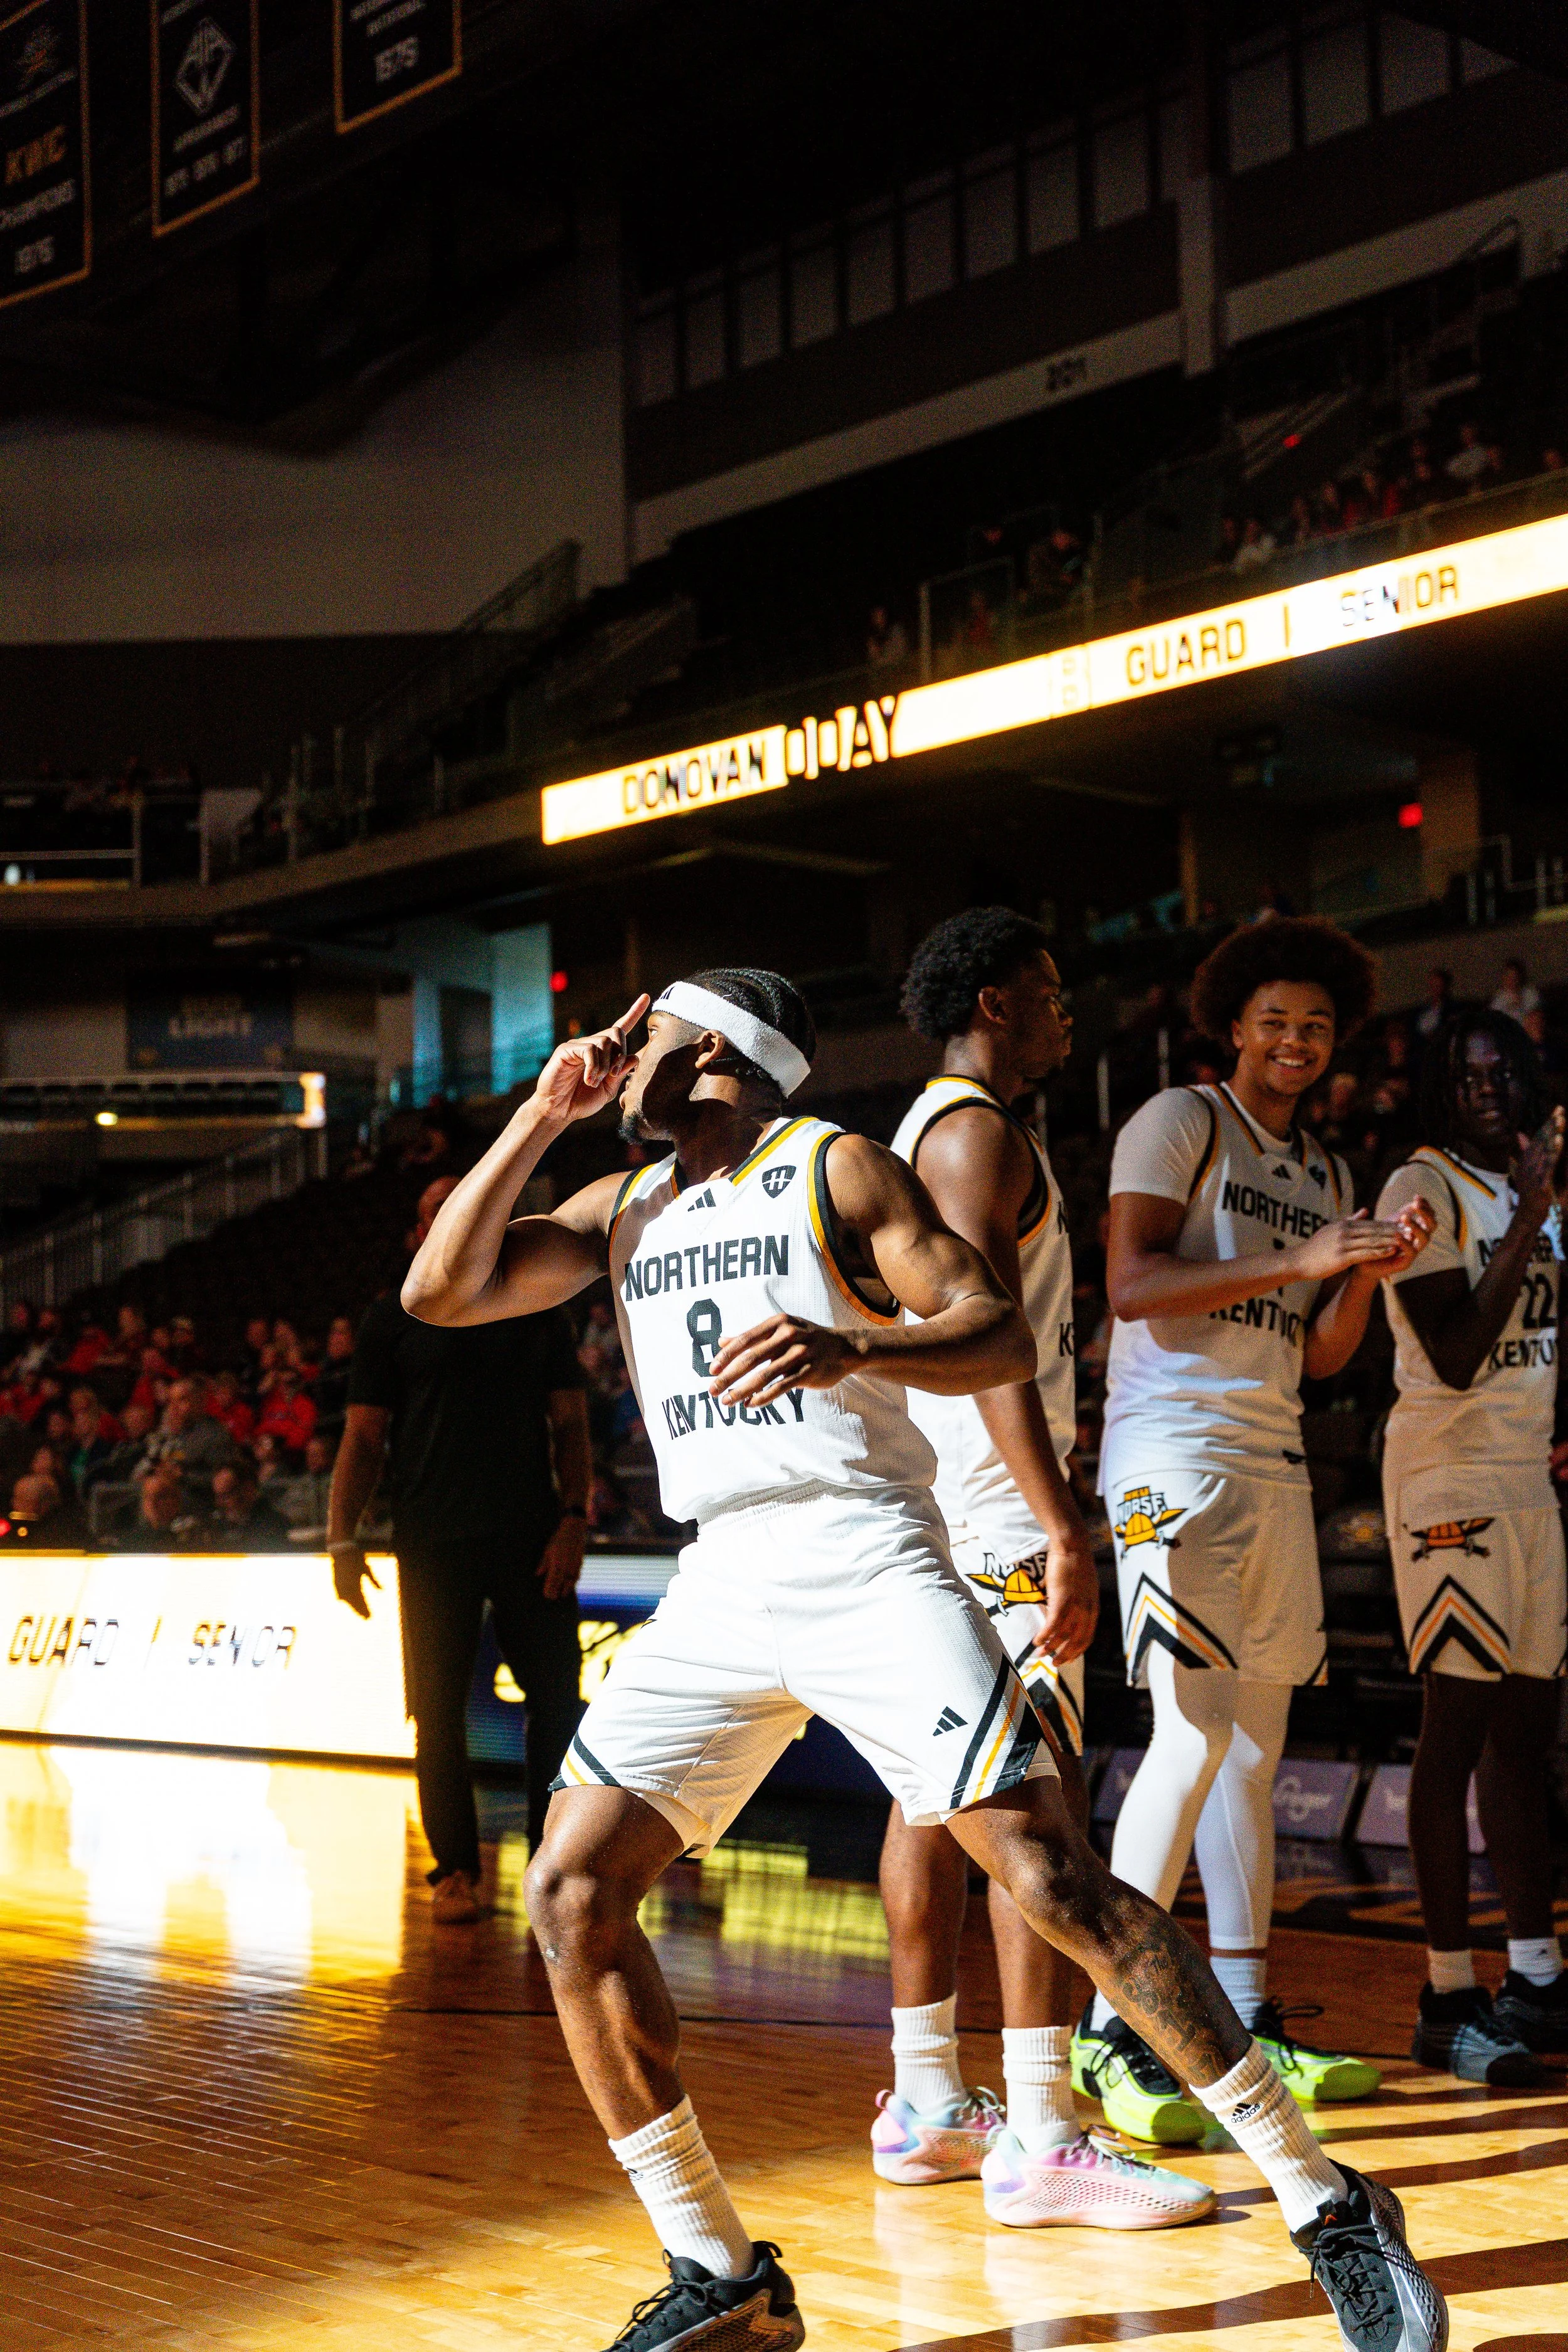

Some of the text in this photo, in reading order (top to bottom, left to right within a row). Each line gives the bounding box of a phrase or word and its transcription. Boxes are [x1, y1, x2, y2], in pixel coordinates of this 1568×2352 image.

[623, 738, 765, 812] DONOVAN
[1126, 620, 1244, 686] GUARD
[1341, 566, 1458, 627] SENIOR
[625, 1235, 789, 1302] NORTHERN
[1522, 1273, 1557, 1328] 22
[687, 1298, 722, 1377] 8
[8, 1616, 119, 1666] GUARD
[1231, 2104, 1261, 2124] adidas
